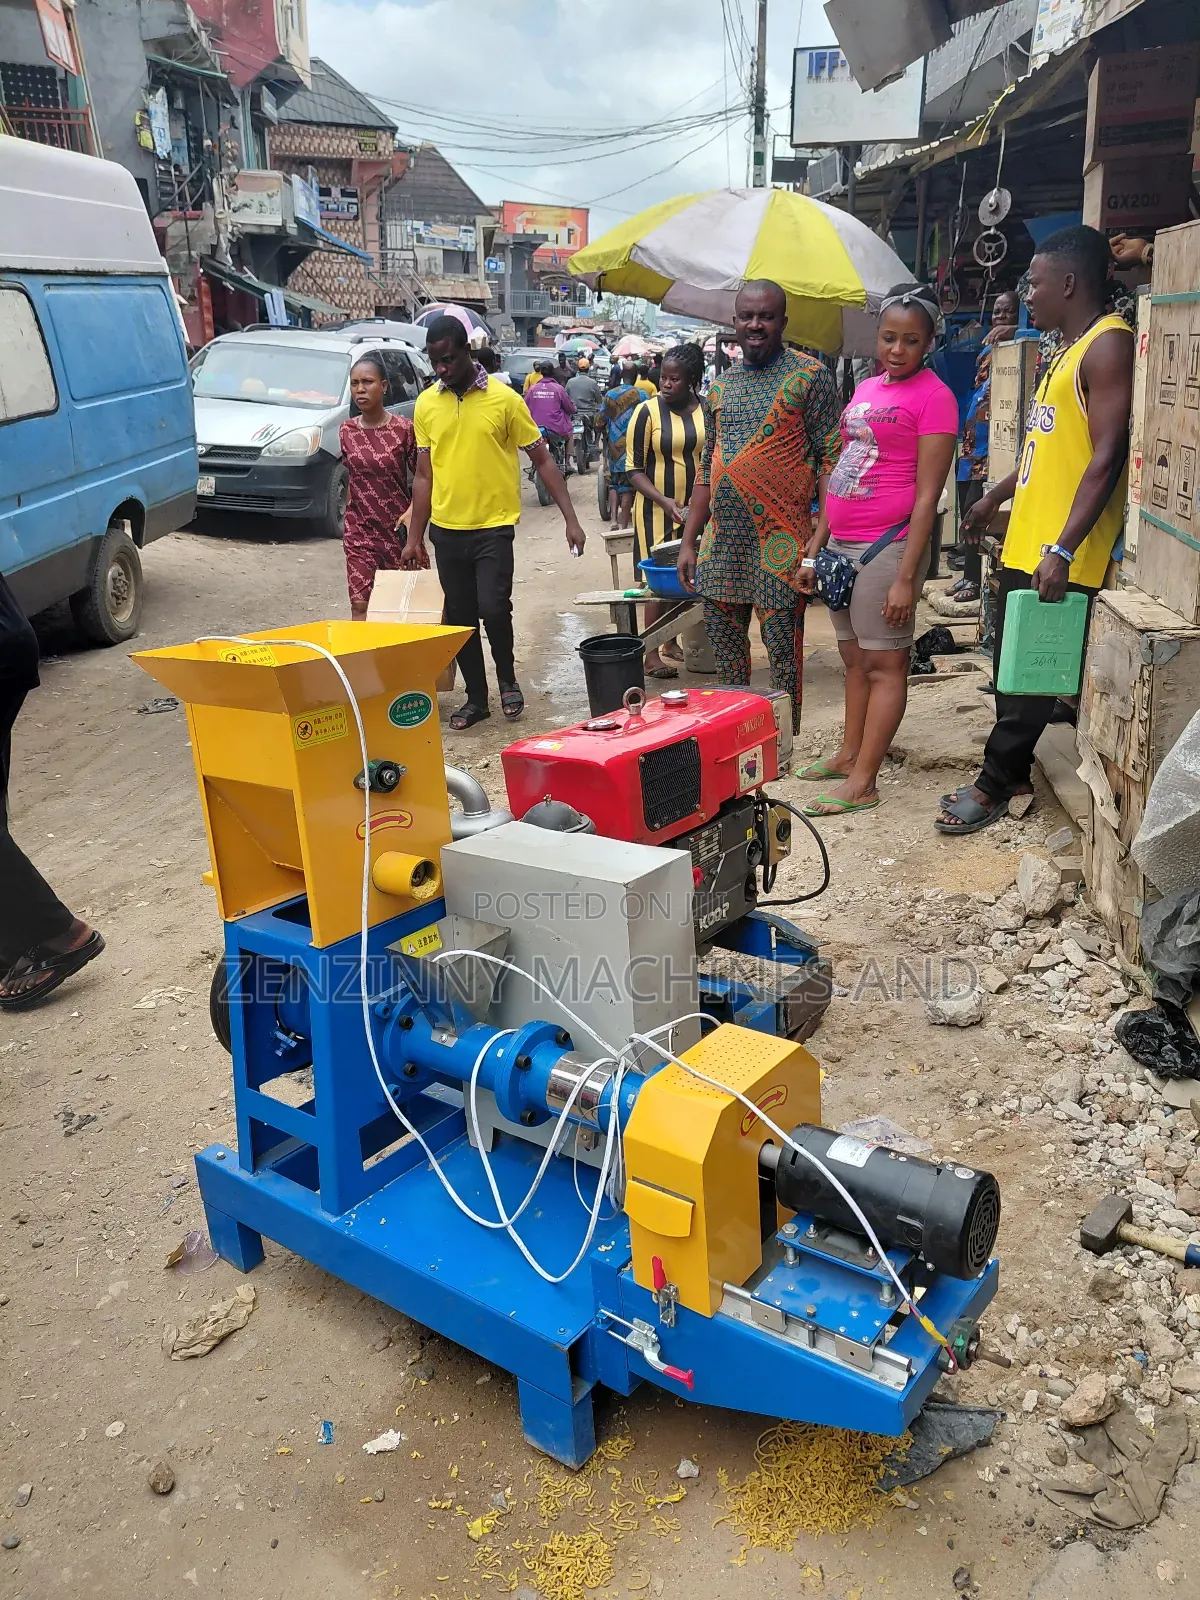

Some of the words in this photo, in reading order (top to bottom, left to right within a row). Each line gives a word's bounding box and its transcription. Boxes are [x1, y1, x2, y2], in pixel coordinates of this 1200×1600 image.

[1107, 193, 1160, 210] GX200
[698, 901, 730, 932] KOOP
[417, 932, 439, 948] 注意加水
